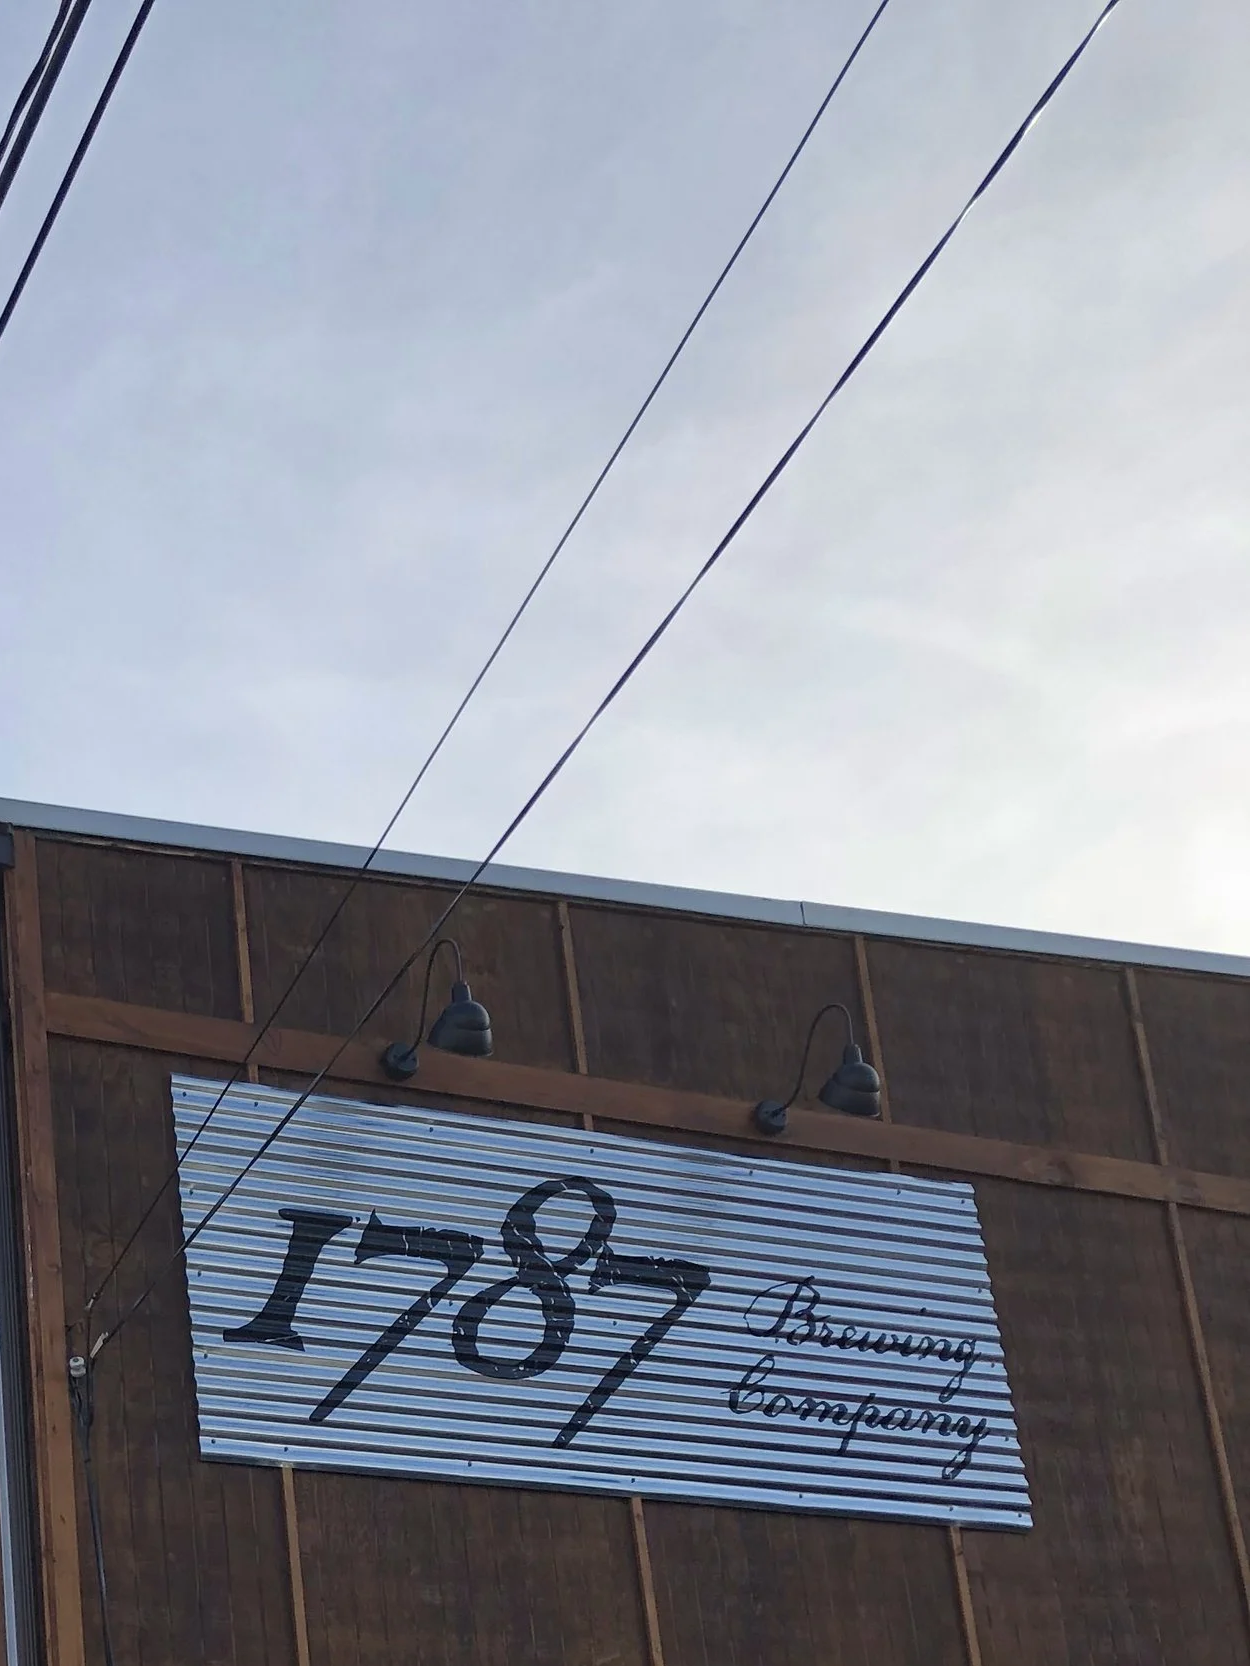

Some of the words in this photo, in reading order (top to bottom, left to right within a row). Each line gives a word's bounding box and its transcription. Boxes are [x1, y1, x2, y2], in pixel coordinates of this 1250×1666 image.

[223, 1176, 712, 1449] 1787
[744, 1275, 981, 1402] Brewing
[729, 1354, 990, 1479] Company
